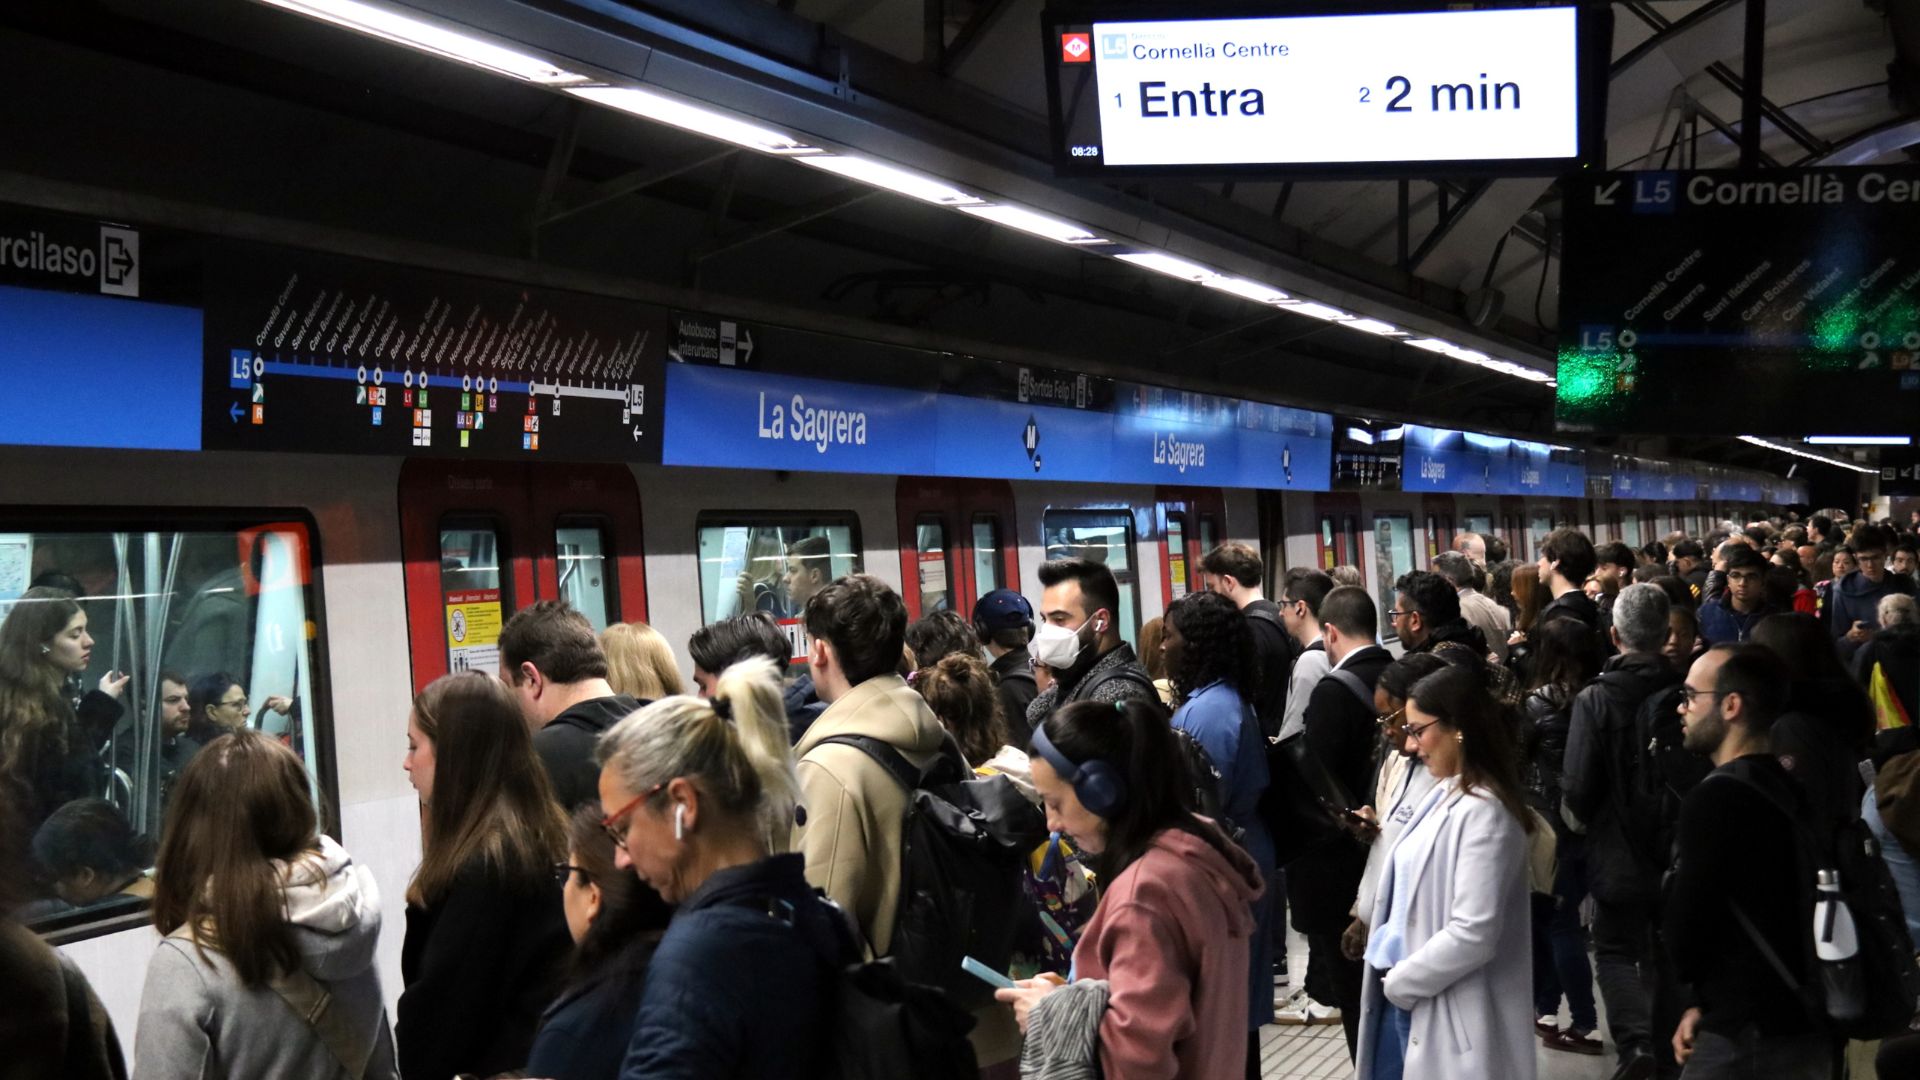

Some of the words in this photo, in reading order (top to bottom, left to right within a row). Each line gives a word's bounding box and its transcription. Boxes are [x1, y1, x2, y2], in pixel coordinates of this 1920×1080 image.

[1132, 42, 1216, 60] Cornellà
[1222, 41, 1290, 58] Centre
[1114, 92, 1123, 108] 1
[1138, 81, 1266, 118] Entra
[1359, 86, 1371, 104] 2
[1384, 76, 1413, 114] 2
[1430, 74, 1521, 111] min
[1072, 146, 1098, 157] 08:28
[1636, 182, 1672, 204] L5
[1686, 174, 1844, 206] Cornellà
[0, 231, 96, 277] rcilaso
[1662, 283, 1706, 322] Gavarra
[1741, 298, 1766, 322] Can
[678, 320, 717, 340] Autobusos
[1582, 332, 1612, 352] L5
[232, 356, 250, 380] L5
[404, 392, 412, 403] L1
[632, 390, 644, 407] L5
[256, 407, 263, 418] R
[758, 392, 784, 440] La
[790, 394, 866, 454] Sagrera
[1027, 426, 1036, 449] M
[1154, 432, 1166, 464] La
[1168, 432, 1205, 474] Sagrera
[1421, 456, 1428, 478] La
